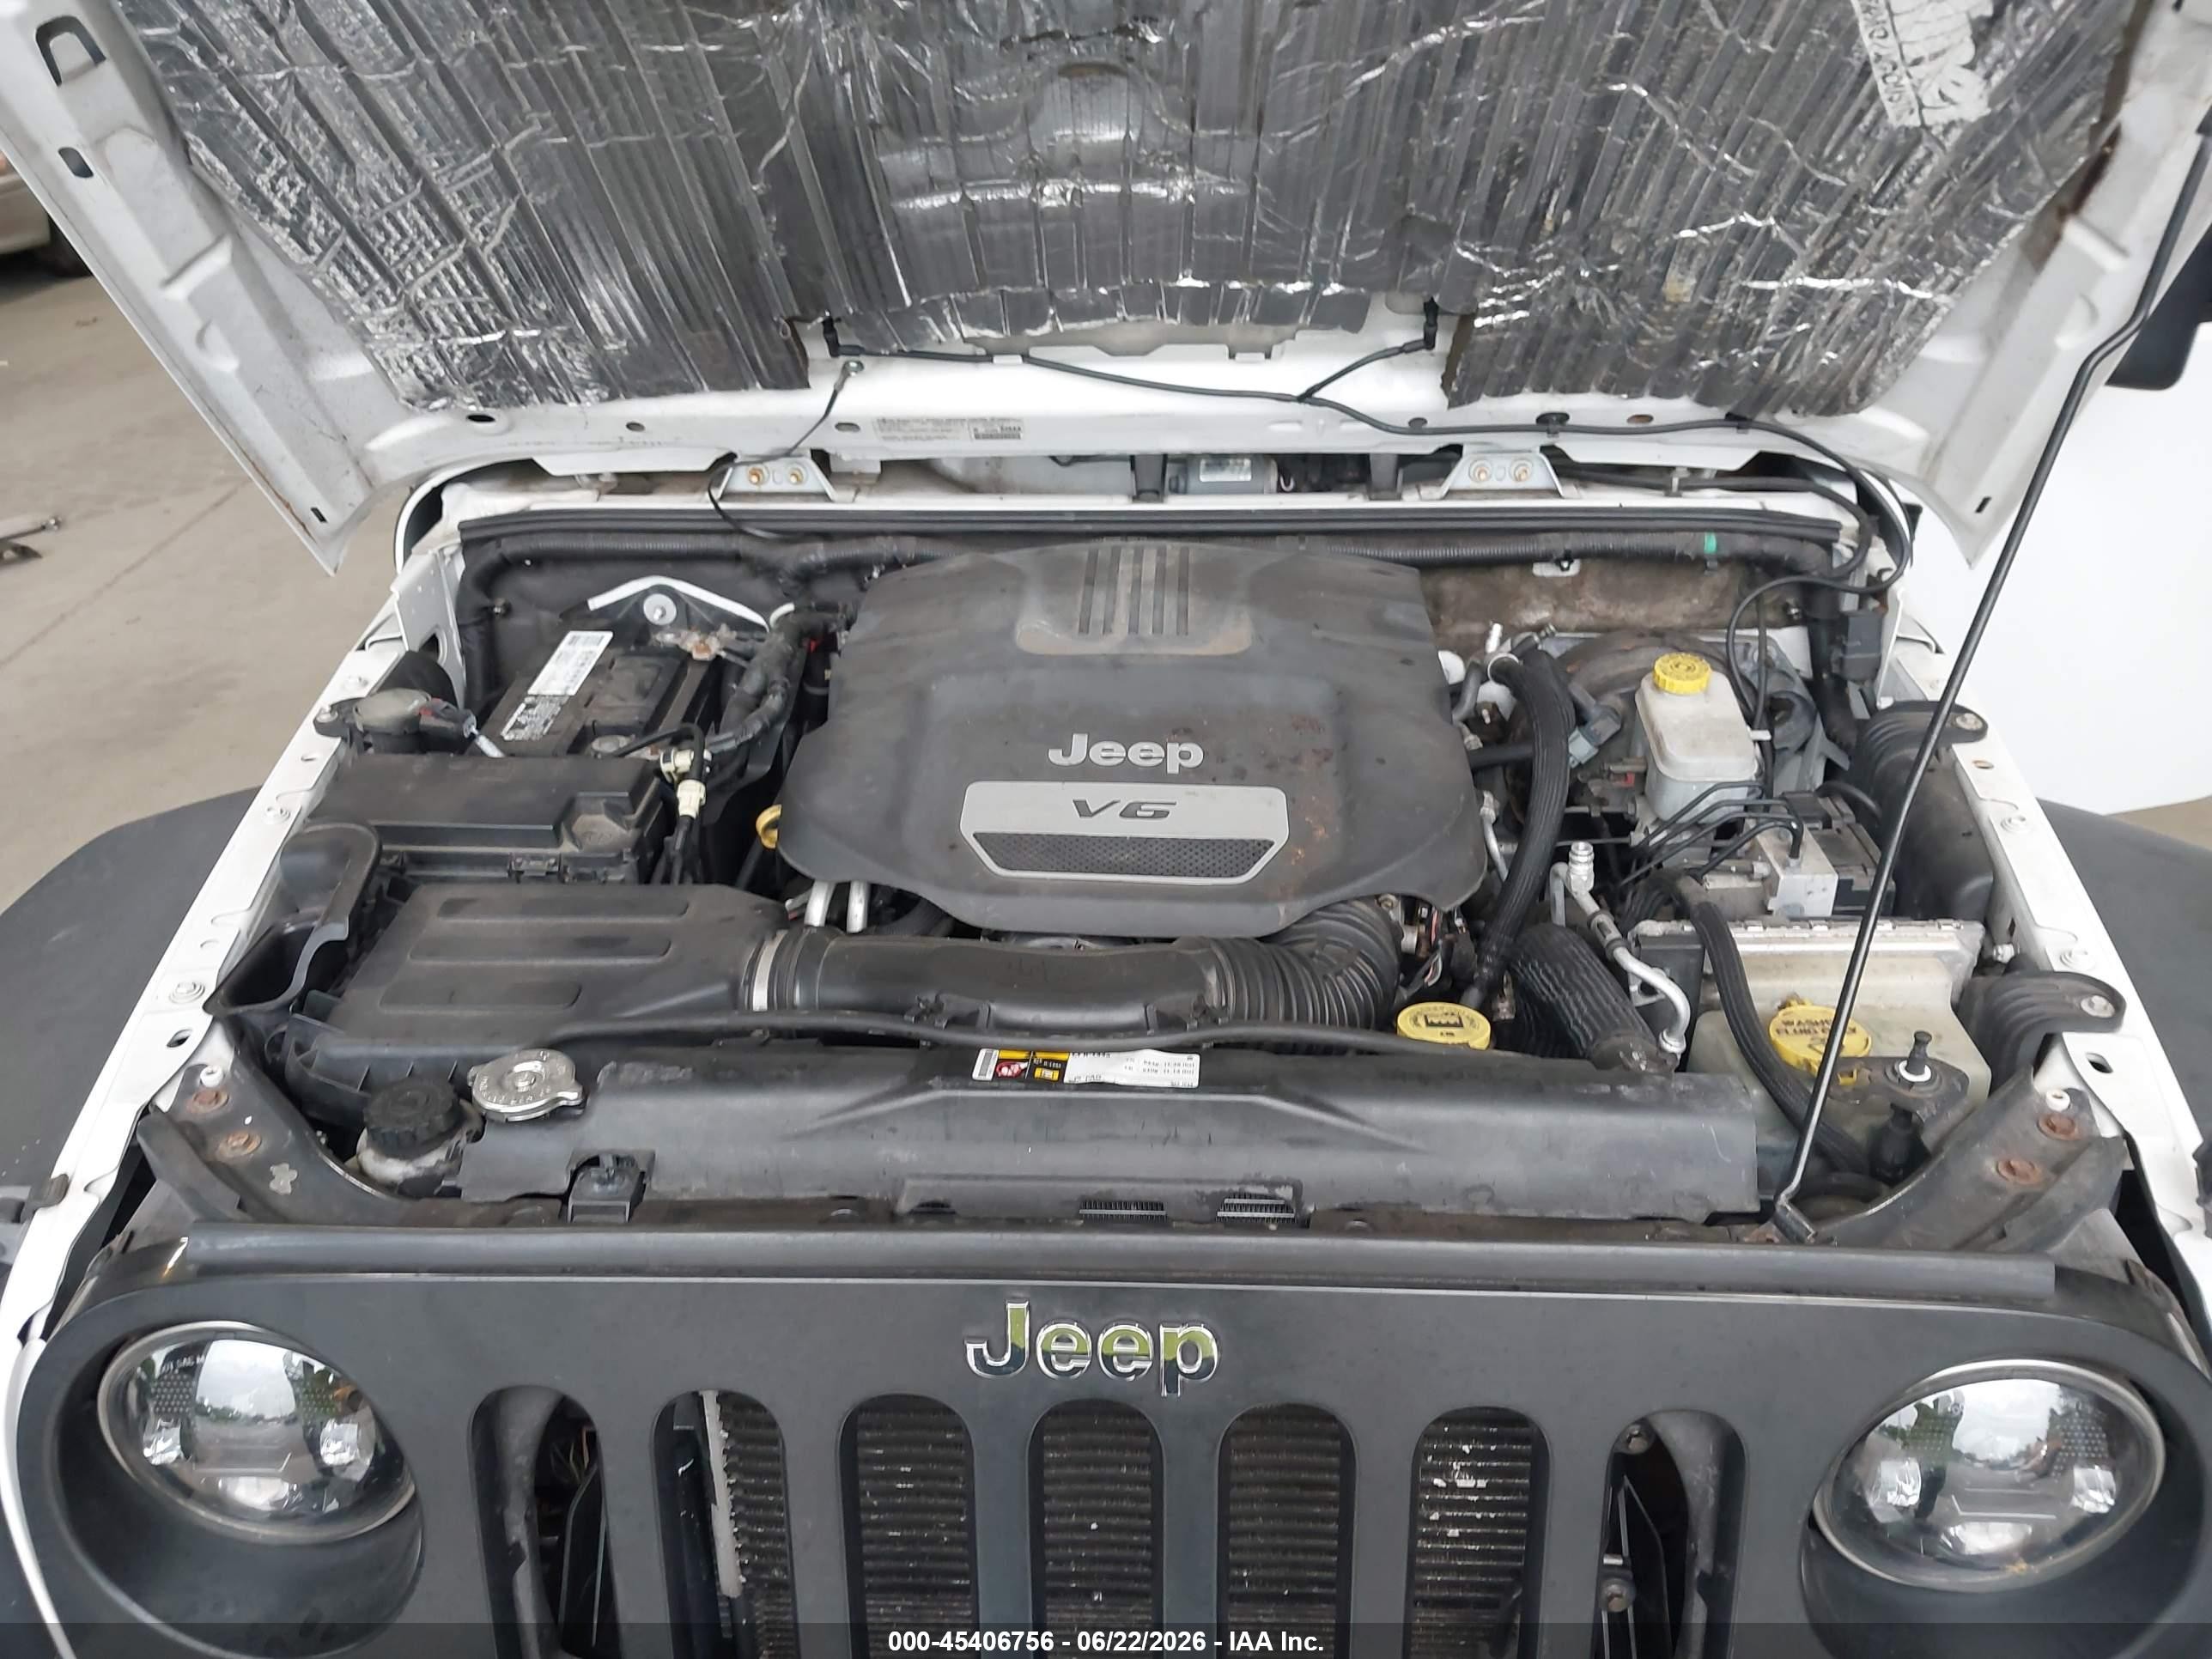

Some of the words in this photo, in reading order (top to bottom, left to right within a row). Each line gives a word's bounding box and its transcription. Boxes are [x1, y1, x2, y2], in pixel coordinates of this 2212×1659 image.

[1047, 732, 1205, 775] Jeep
[1073, 799, 1177, 818] V6
[964, 1297, 1220, 1397] Jeep
